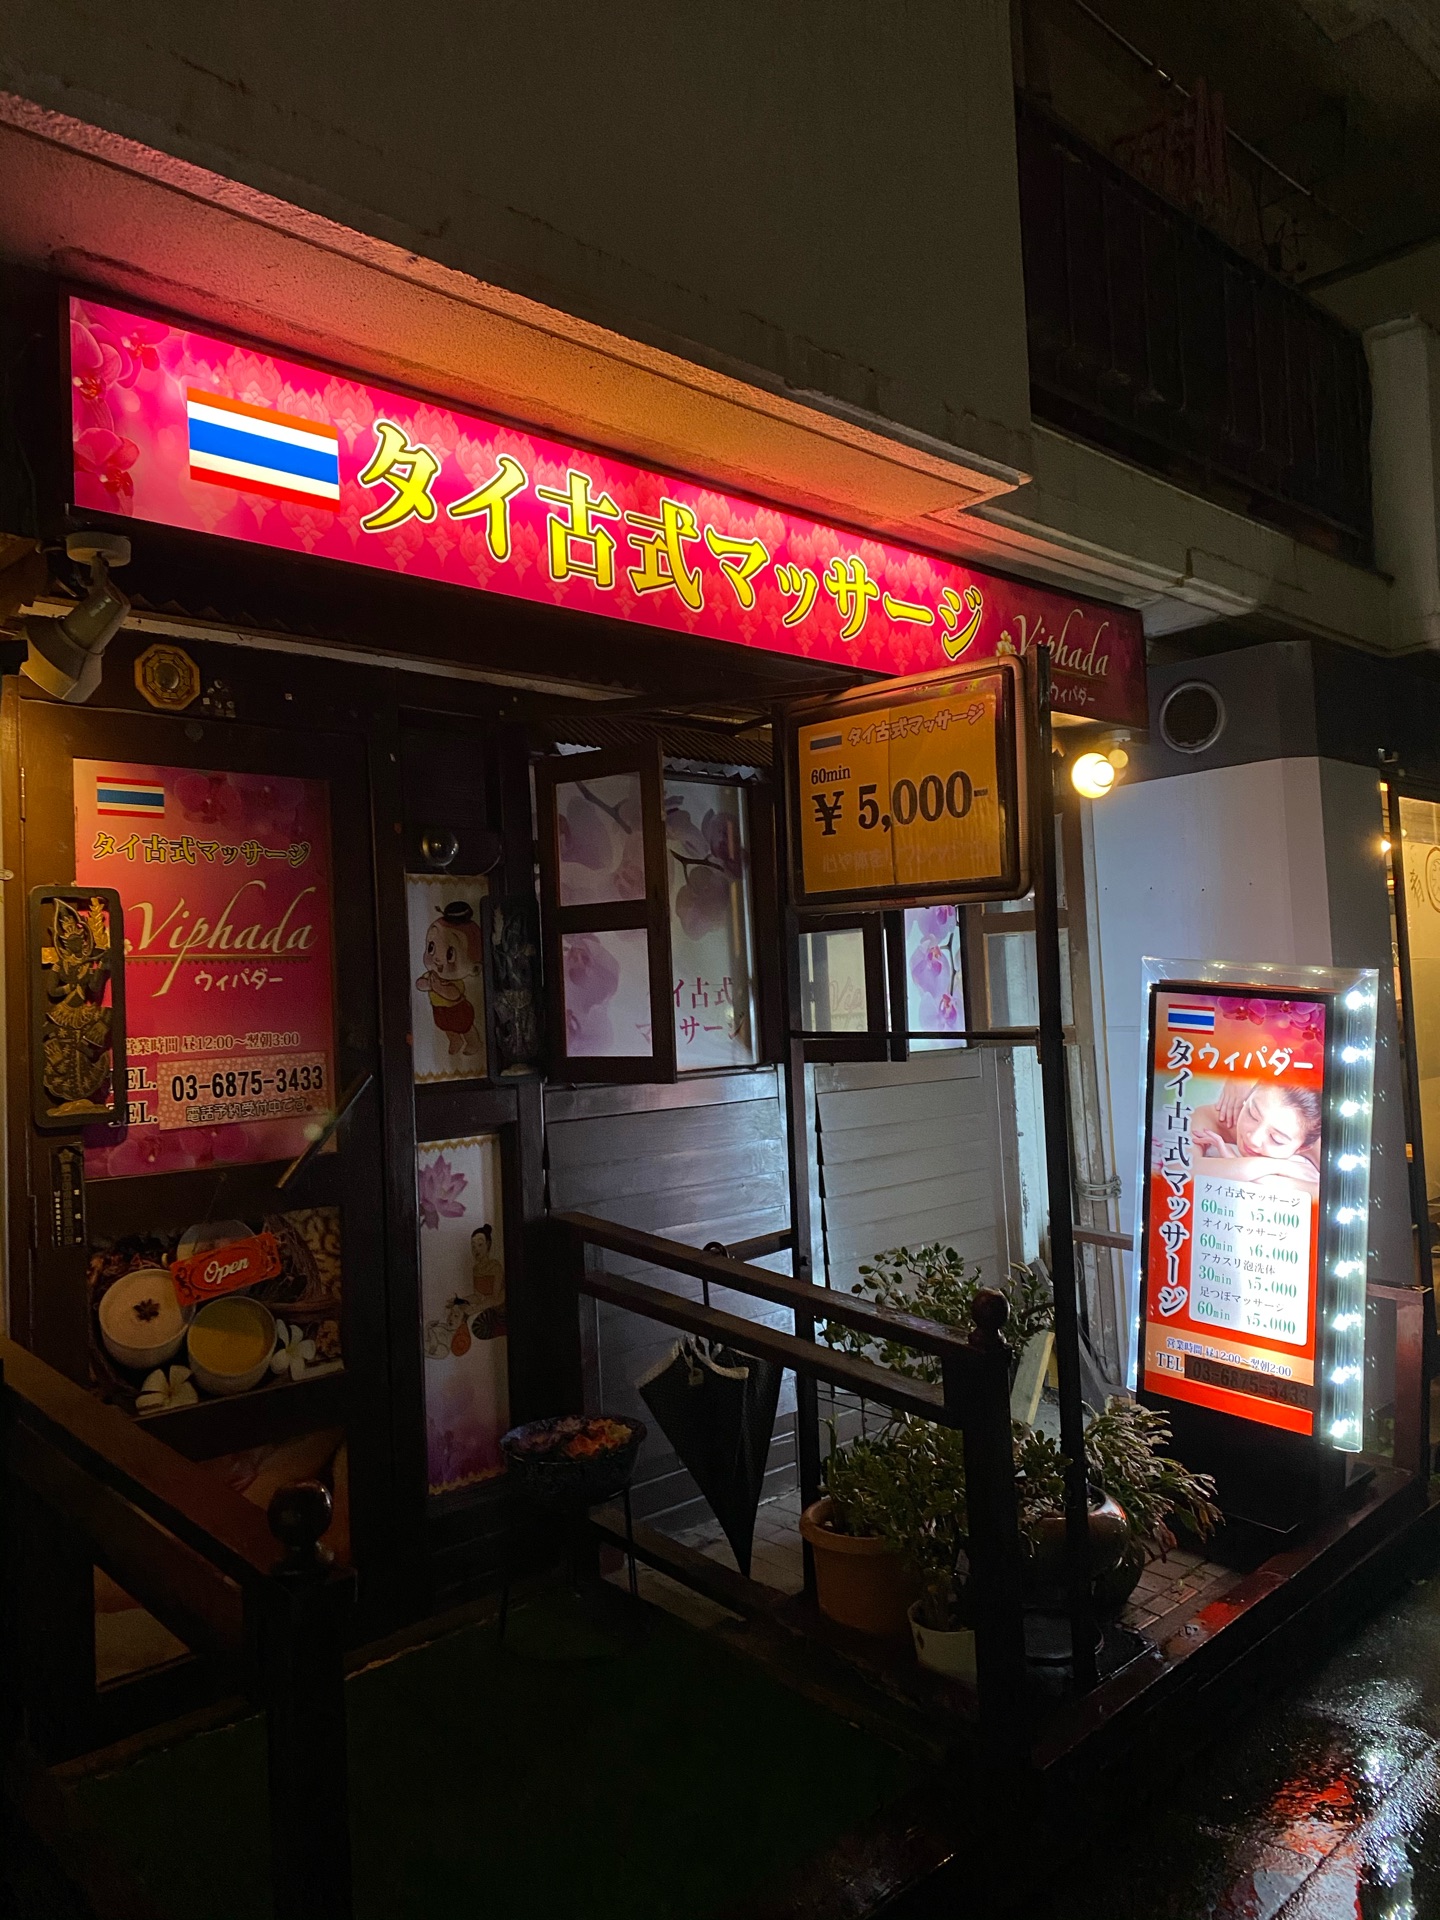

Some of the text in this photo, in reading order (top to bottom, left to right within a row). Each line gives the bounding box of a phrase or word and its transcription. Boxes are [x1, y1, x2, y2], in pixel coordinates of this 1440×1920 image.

[358, 418, 985, 661] タイ古式マッサージ
[847, 702, 986, 746] タイ古式マッサージ
[811, 765, 851, 785] 60min
[92, 832, 312, 869] タイ古式マッサージ
[128, 879, 317, 997] Viphada
[194, 968, 283, 991] ウィパダー
[1198, 1042, 1314, 1076] ウィパダー
[110, 1065, 323, 1102] EL. 03-6875-3433
[1158, 1038, 1194, 1318] タイ古式マッサージ
[1204, 1182, 1301, 1207] タイ古式マッサージ
[1201, 1199, 1234, 1218] 60min
[1200, 1233, 1234, 1252] 60min
[1202, 1217, 1288, 1241] オイルマッサージ
[203, 1256, 250, 1285] Open
[1198, 1265, 1232, 1285] 30min
[1197, 1301, 1230, 1321] 60min
[1199, 1286, 1284, 1312] 足つぼマッサージ
[1156, 1352, 1308, 1405] TEL 03-6875-3433
